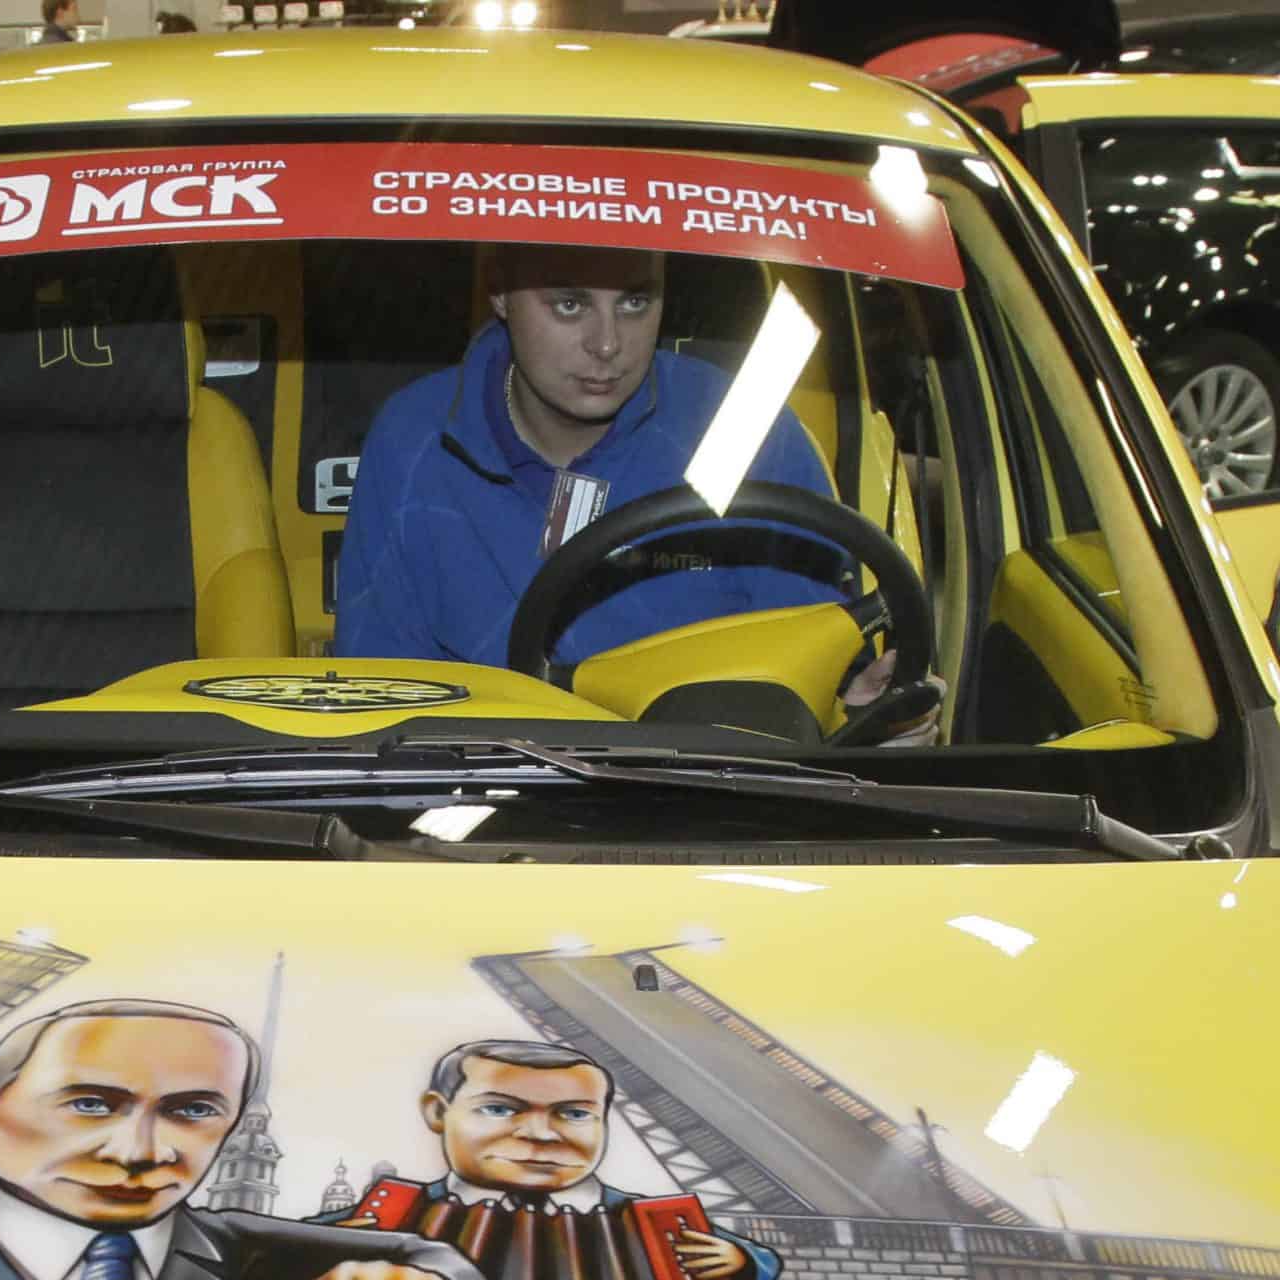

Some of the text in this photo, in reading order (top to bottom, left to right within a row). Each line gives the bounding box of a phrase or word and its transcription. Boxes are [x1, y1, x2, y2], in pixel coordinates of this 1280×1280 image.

[71, 159, 287, 180] СТРАХОВАЯ ГРУППА
[68, 173, 279, 225] МСК
[371, 195, 808, 241] СО ЗНАНИЕМ ДЕЛА!
[372, 171, 878, 227] СТРАХОВЫЕ ПРОДУКТЫ
